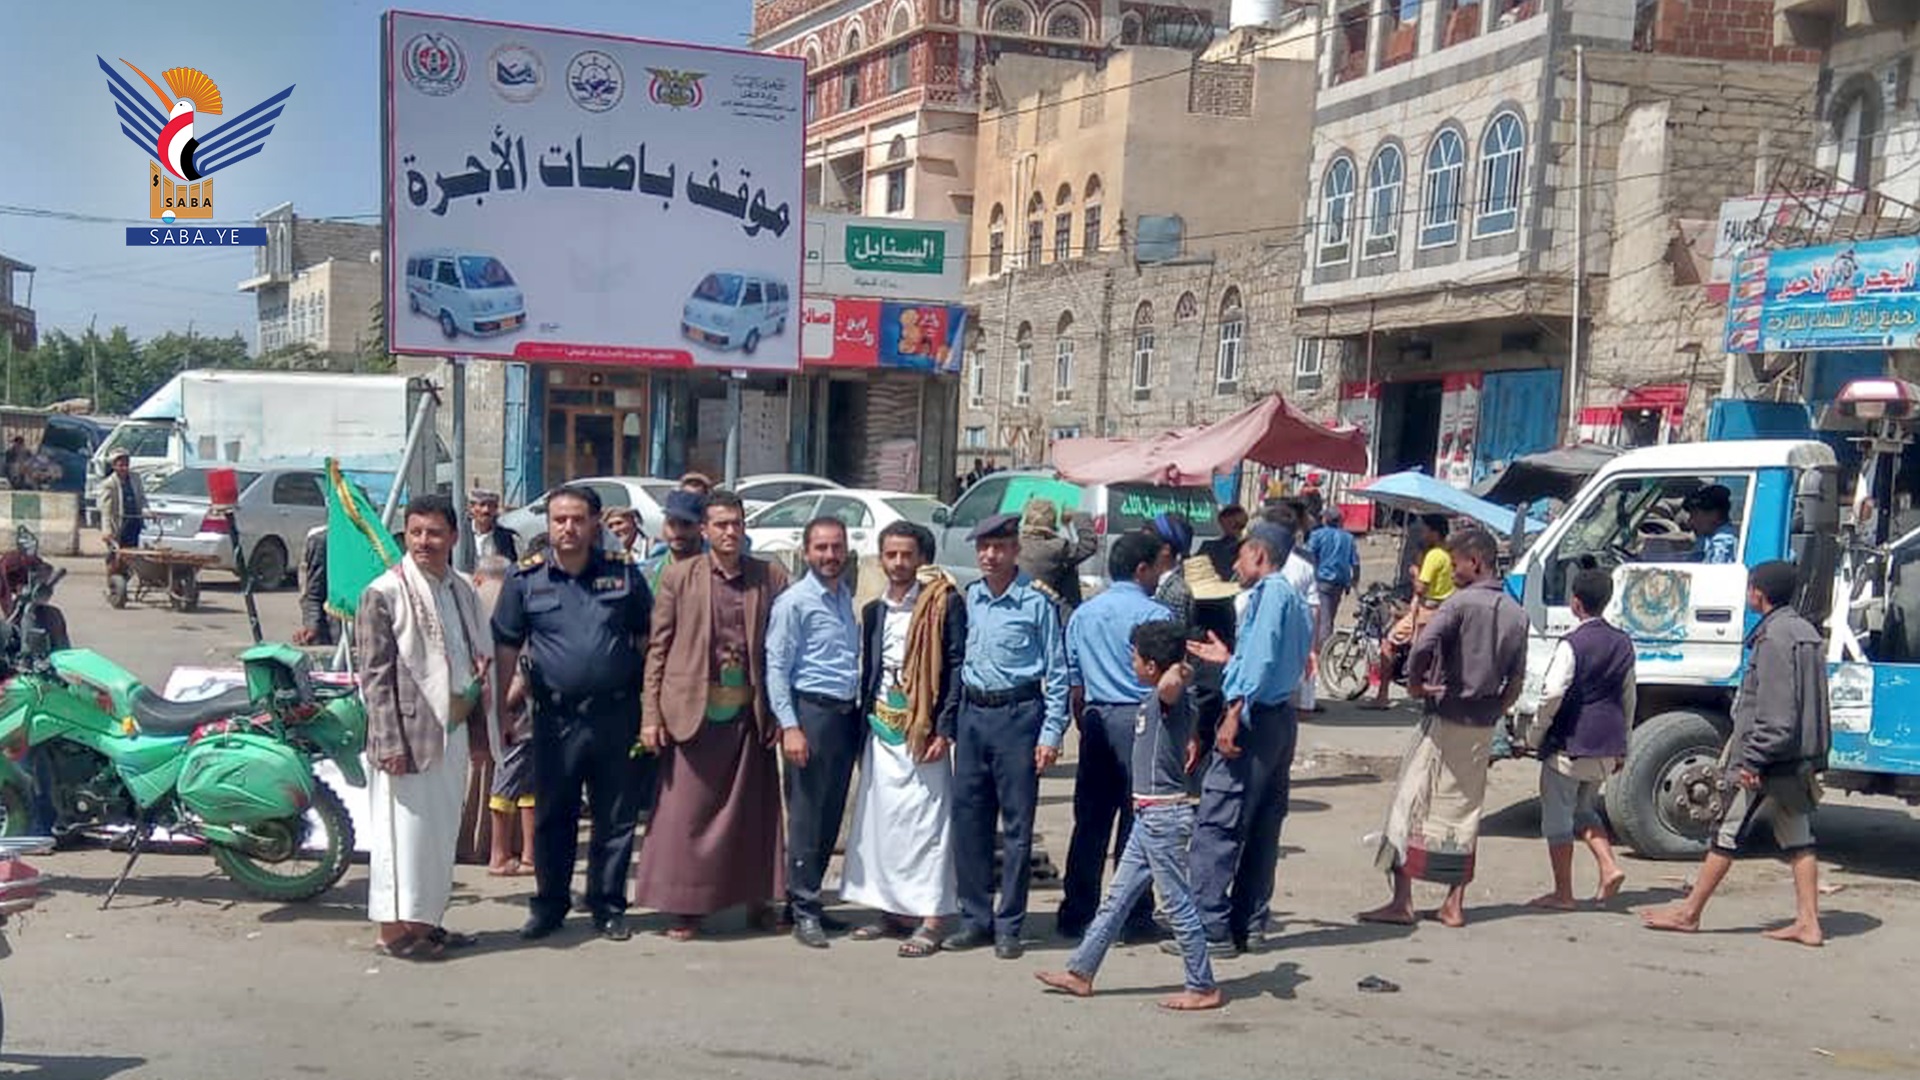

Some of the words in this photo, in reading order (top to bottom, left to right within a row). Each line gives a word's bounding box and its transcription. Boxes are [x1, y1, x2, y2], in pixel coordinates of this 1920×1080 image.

[403, 125, 526, 216] الأجرة
[539, 136, 674, 210] باصات
[687, 159, 790, 237] موقف
[852, 233, 935, 262] السنابل
